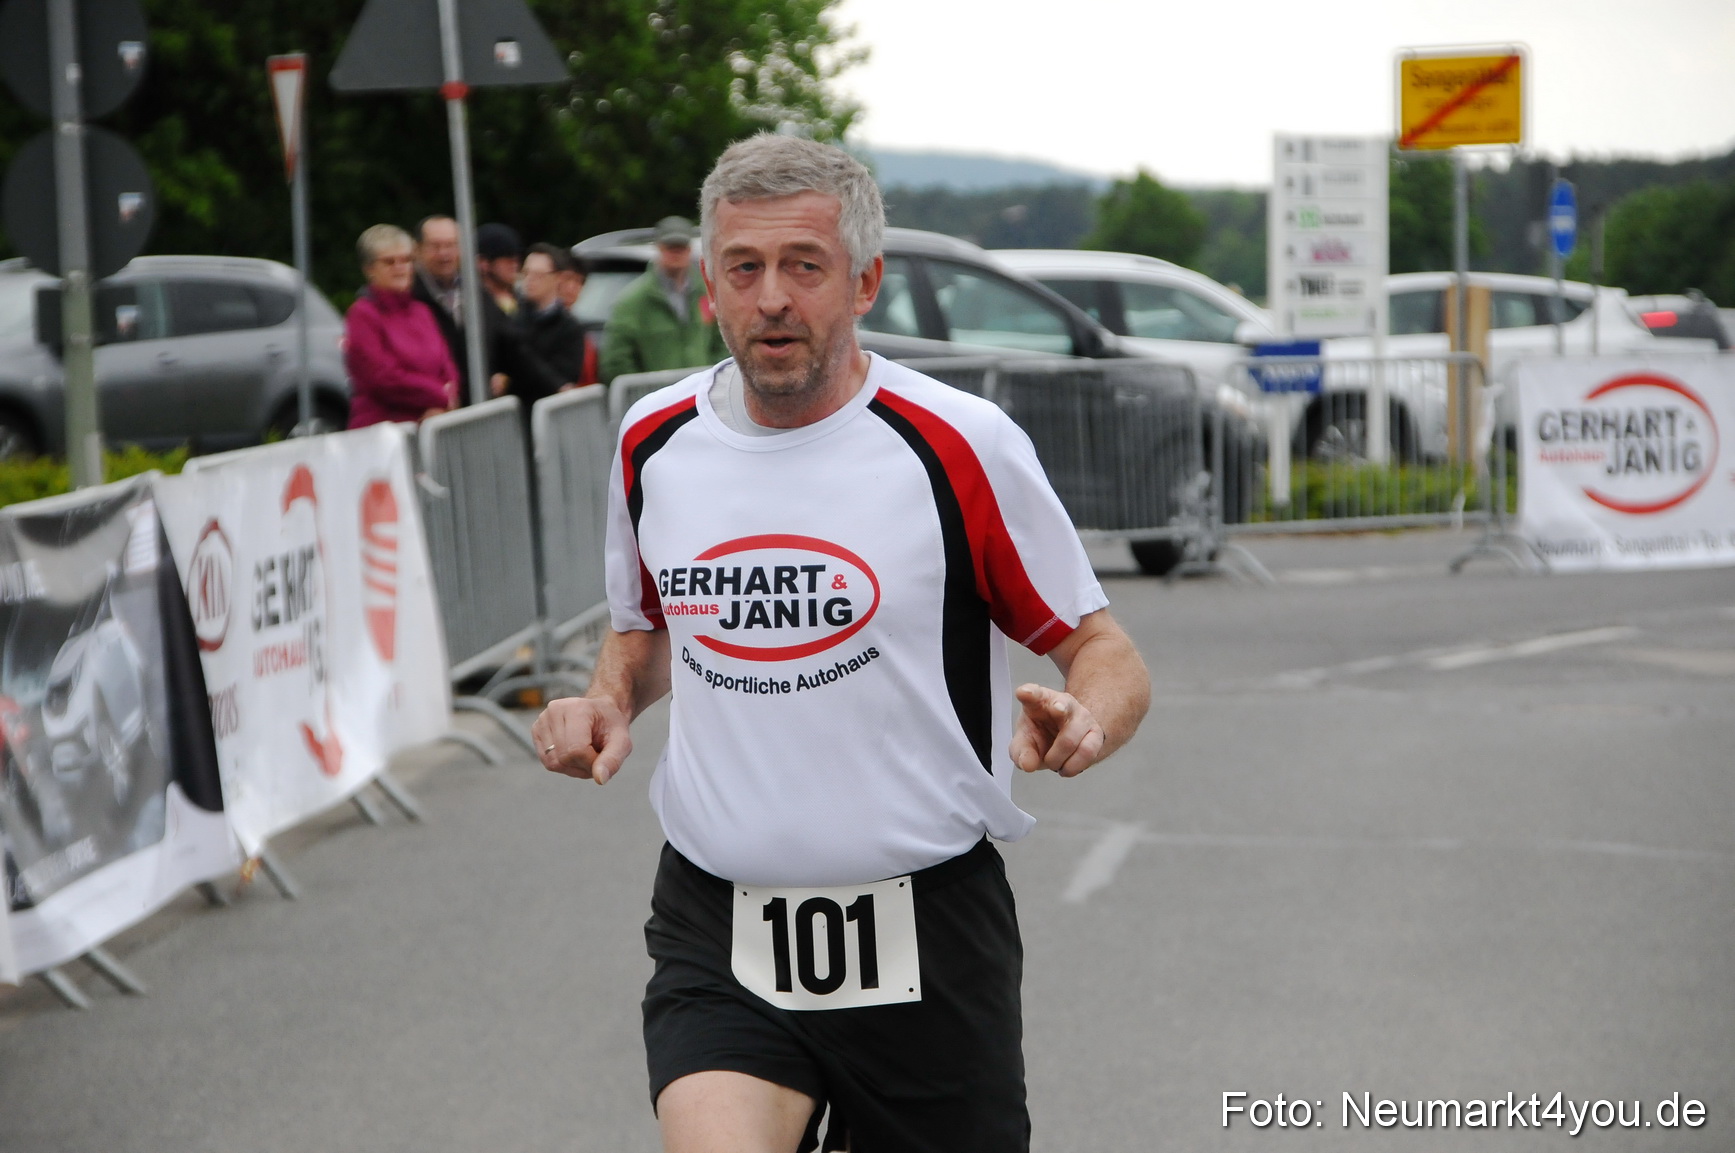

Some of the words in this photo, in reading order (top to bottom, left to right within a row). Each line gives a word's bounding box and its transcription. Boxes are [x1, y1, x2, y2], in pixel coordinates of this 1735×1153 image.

[1538, 408, 1681, 442] GERHART
[658, 564, 826, 598] GERHART
[831, 573, 848, 590] &
[663, 602, 720, 616] utohaus
[718, 597, 853, 631] JÄNIG
[681, 646, 703, 677] Das
[704, 667, 792, 695] sportliche
[795, 645, 880, 693] Autohaus
[762, 893, 880, 996] 101
